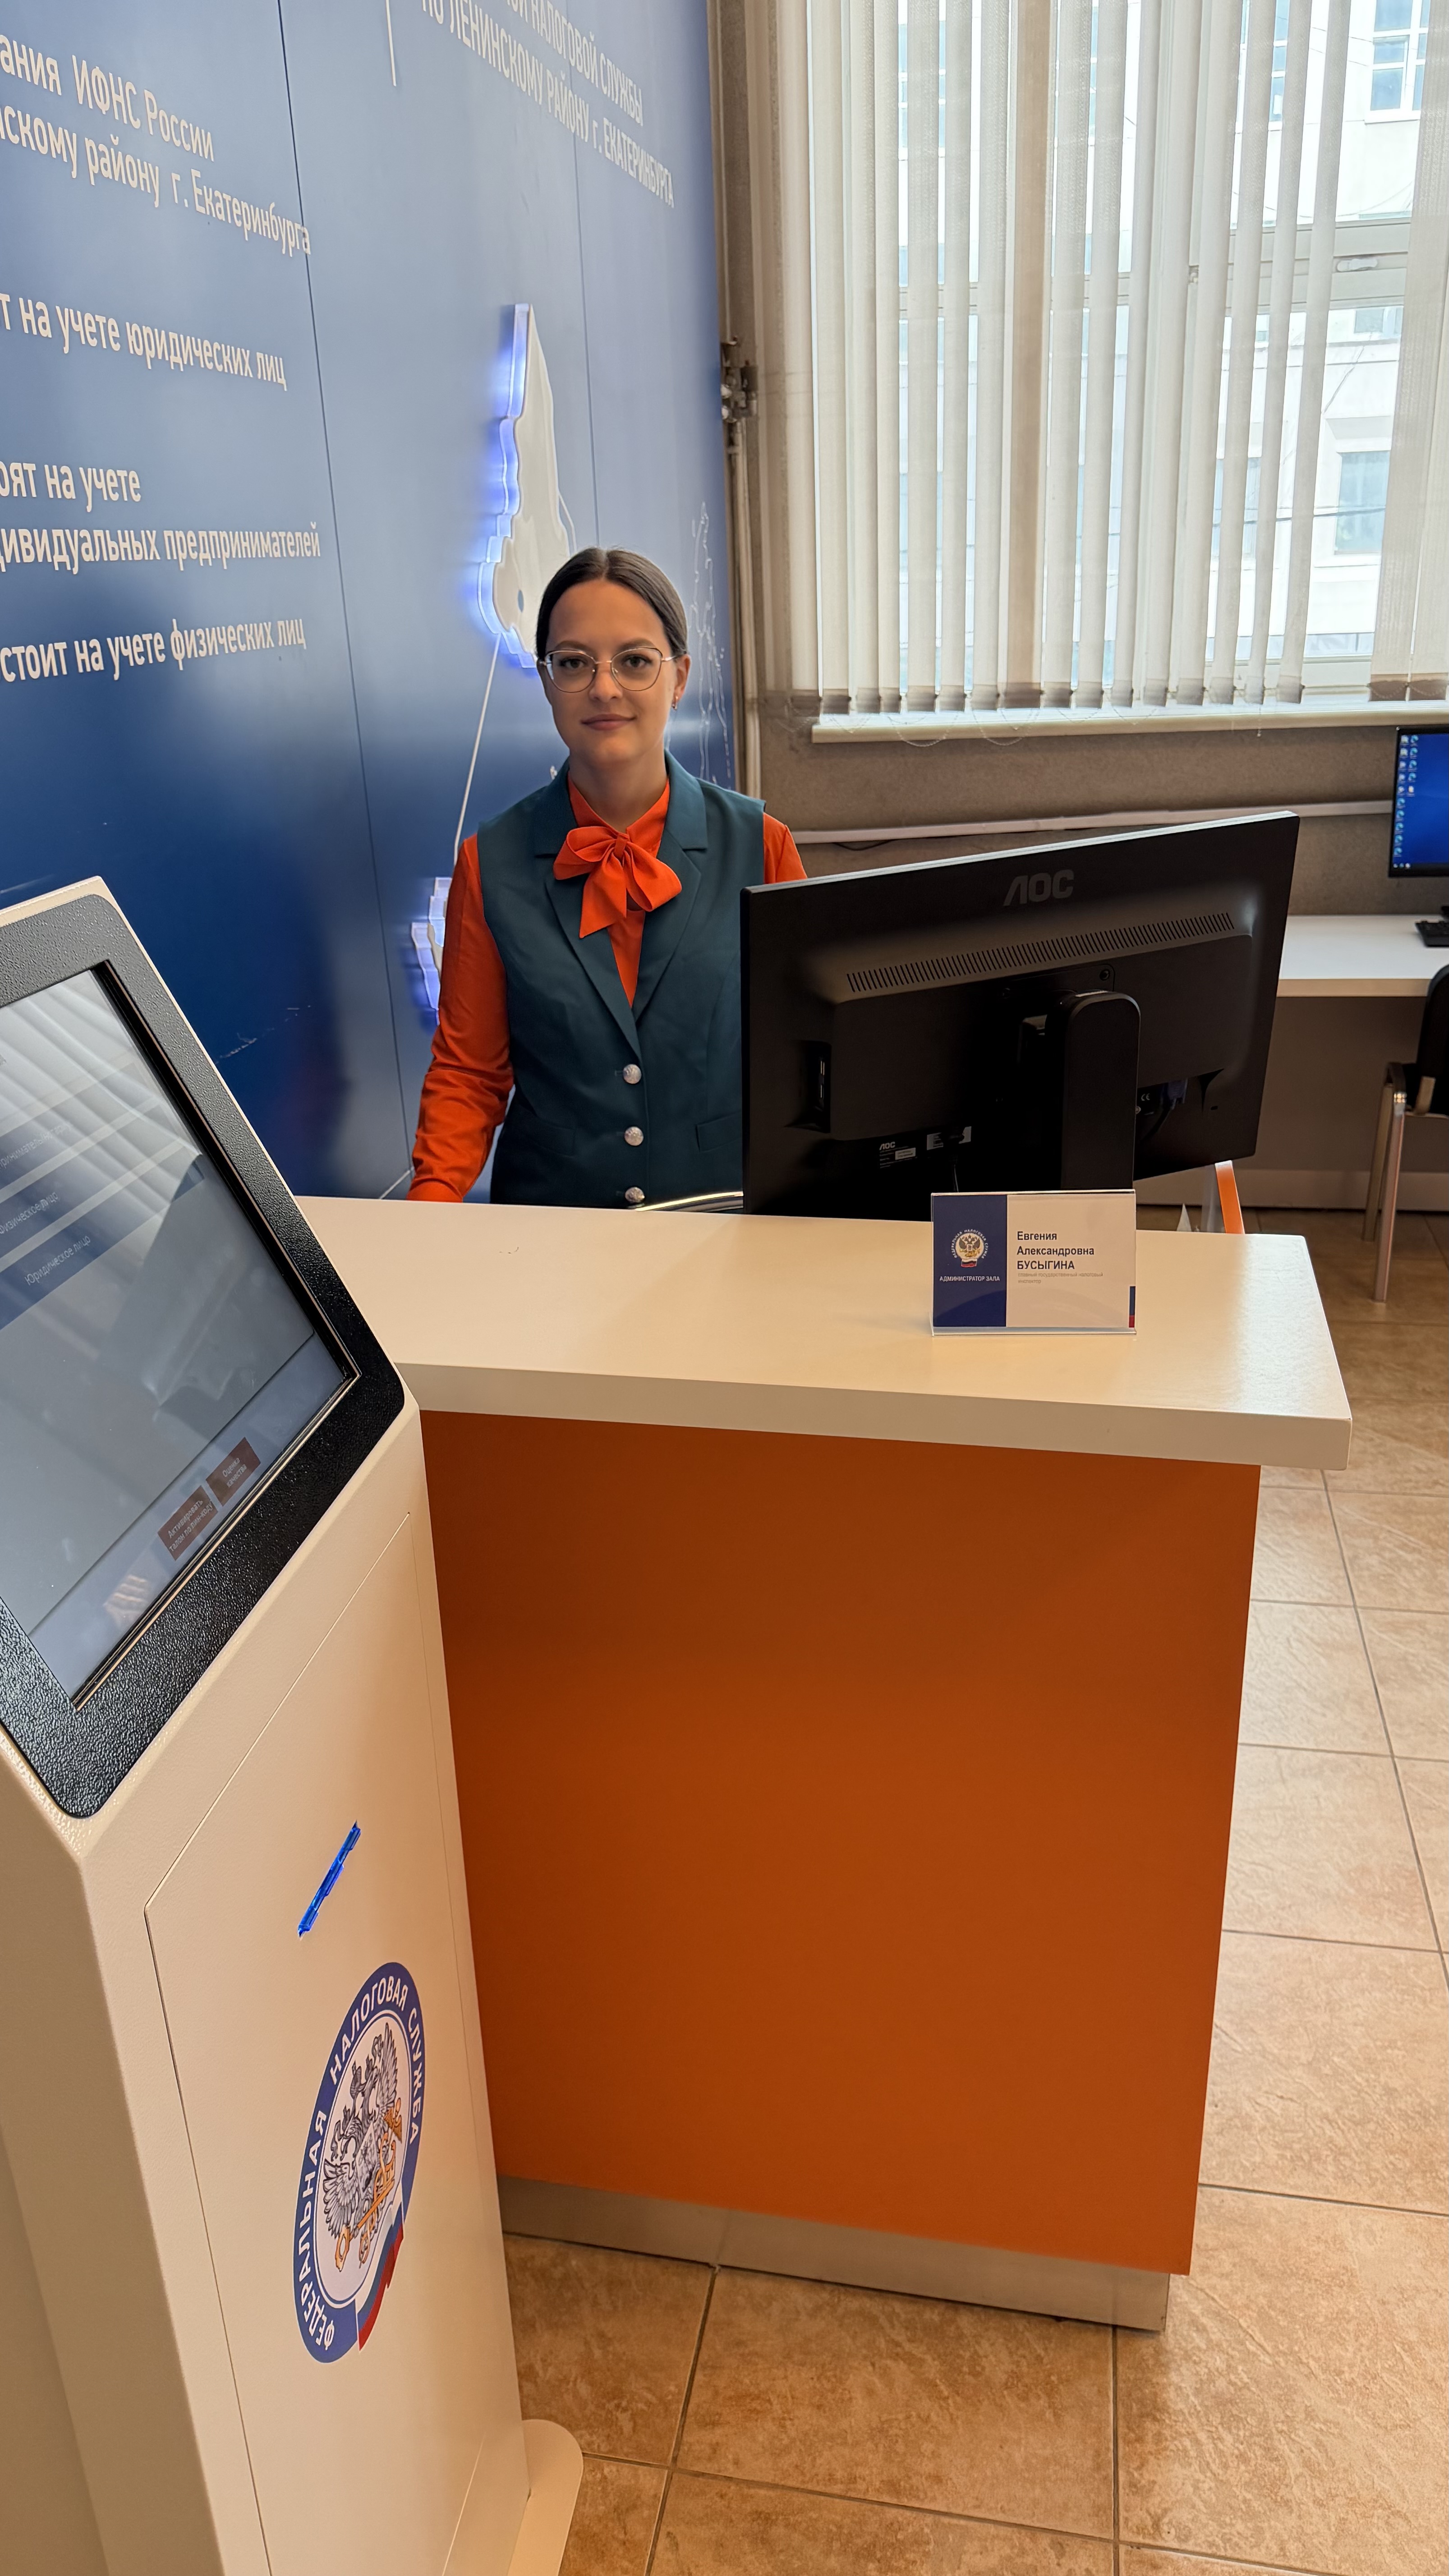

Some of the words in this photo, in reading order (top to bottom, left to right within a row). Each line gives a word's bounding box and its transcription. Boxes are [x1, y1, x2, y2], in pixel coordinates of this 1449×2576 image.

[0, 35, 62, 96] ания
[72, 55, 141, 129] ИФНС
[144, 89, 214, 162] России
[600, 53, 643, 126] СЛУЖБЫ
[547, 69, 589, 142] РАЙОНУ
[593, 120, 602, 153] г.
[603, 117, 674, 208] ЕКАТЕРИНБУРГА
[0, 106, 77, 179] скому
[85, 134, 159, 207] району
[171, 173, 188, 207] г.
[191, 168, 311, 255] Екатеринбурга
[18, 297, 52, 338] на
[55, 305, 121, 354] учете
[125, 322, 253, 378] юридических
[256, 352, 287, 391] лиц
[44, 464, 76, 499] на
[78, 467, 141, 513] учете
[0, 528, 161, 575] ивидуальных
[163, 521, 321, 571] предпринимателей
[0, 641, 68, 682] стоит
[74, 639, 105, 673] на
[106, 632, 166, 681] учете
[170, 618, 275, 671] физических
[277, 619, 306, 649] лиц
[1003, 869, 1074, 906] AOC
[879, 1141, 896, 1150] AOC
[24, 1247, 74, 1286] Юридическое
[73, 1235, 91, 1253] лицо
[1017, 1231, 1057, 1240] Евгения
[1017, 1246, 1095, 1257] Александровна
[1017, 1260, 1075, 1270] БУСЫГИНА
[222, 1457, 240, 1477] Оценка
[226, 1464, 247, 1488] качества
[168, 1500, 203, 1538] Активировать
[169, 1532, 185, 1552] талон
[184, 1526, 192, 1537] по
[191, 1501, 213, 1532] пин-коду
[299, 2110, 335, 2351] ФЕДЕРАЛЬНАЯ
[330, 1976, 408, 2085] НАЛОГОВАЯ
[408, 2007, 422, 2145] СЛУЖБА
